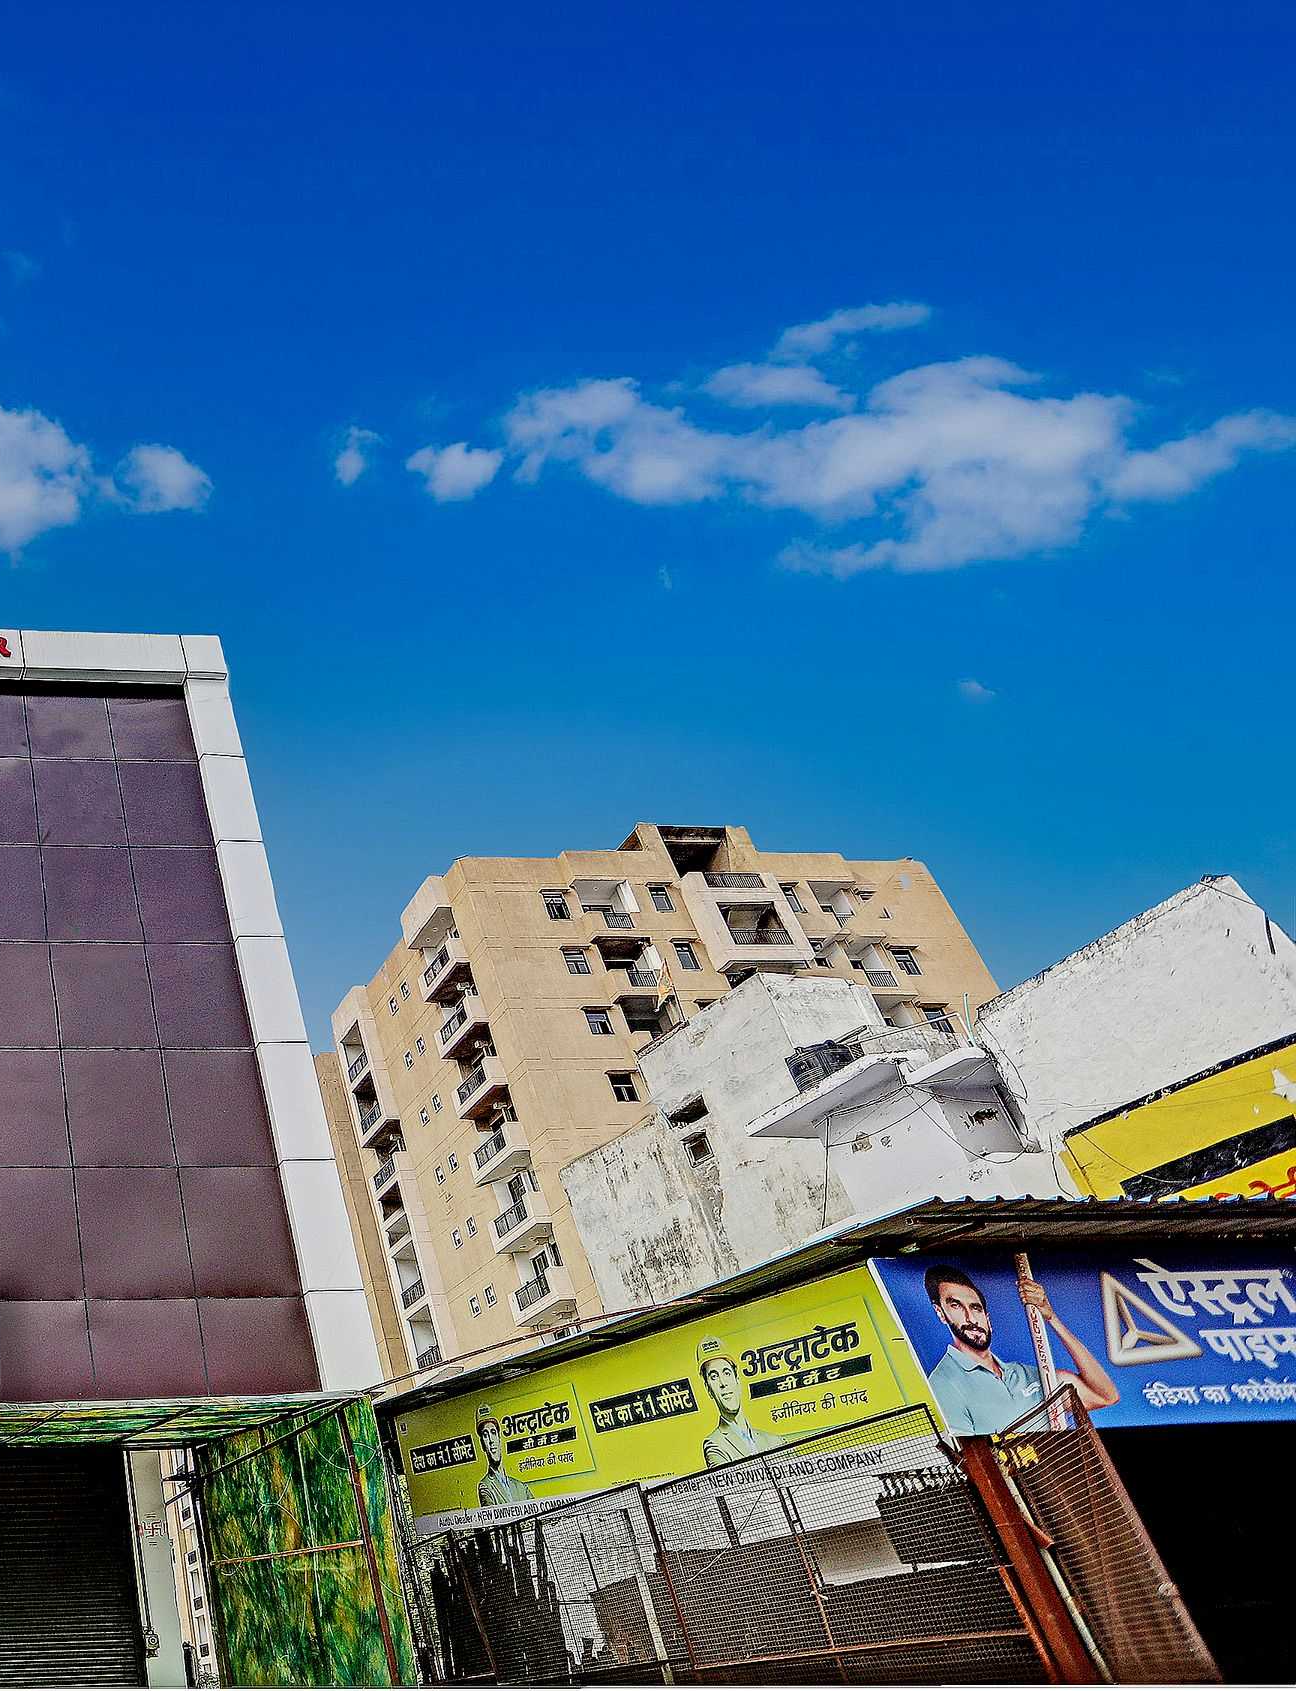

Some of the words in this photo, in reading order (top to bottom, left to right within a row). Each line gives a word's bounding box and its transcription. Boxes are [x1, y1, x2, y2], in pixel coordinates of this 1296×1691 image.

[740, 1322, 860, 1378] अल्ट्राटेक
[594, 1402, 615, 1428] देश
[617, 1401, 634, 1425] का
[656, 1380, 694, 1414] सीमेंट
[770, 1400, 817, 1423] इंजीनियर
[821, 1392, 836, 1411] की
[841, 1389, 869, 1408] पसंद
[1200, 1385, 1231, 1404] का
[502, 1401, 571, 1437] अल्ट्राटेक
[413, 1451, 426, 1470] देश
[426, 1450, 438, 1467] का
[708, 1473, 735, 1490] NEW
[789, 1459, 814, 1480] AND
[817, 1449, 884, 1474] COMPANY
[477, 1509, 493, 1521] NEW
[523, 1503, 539, 1515] AND
